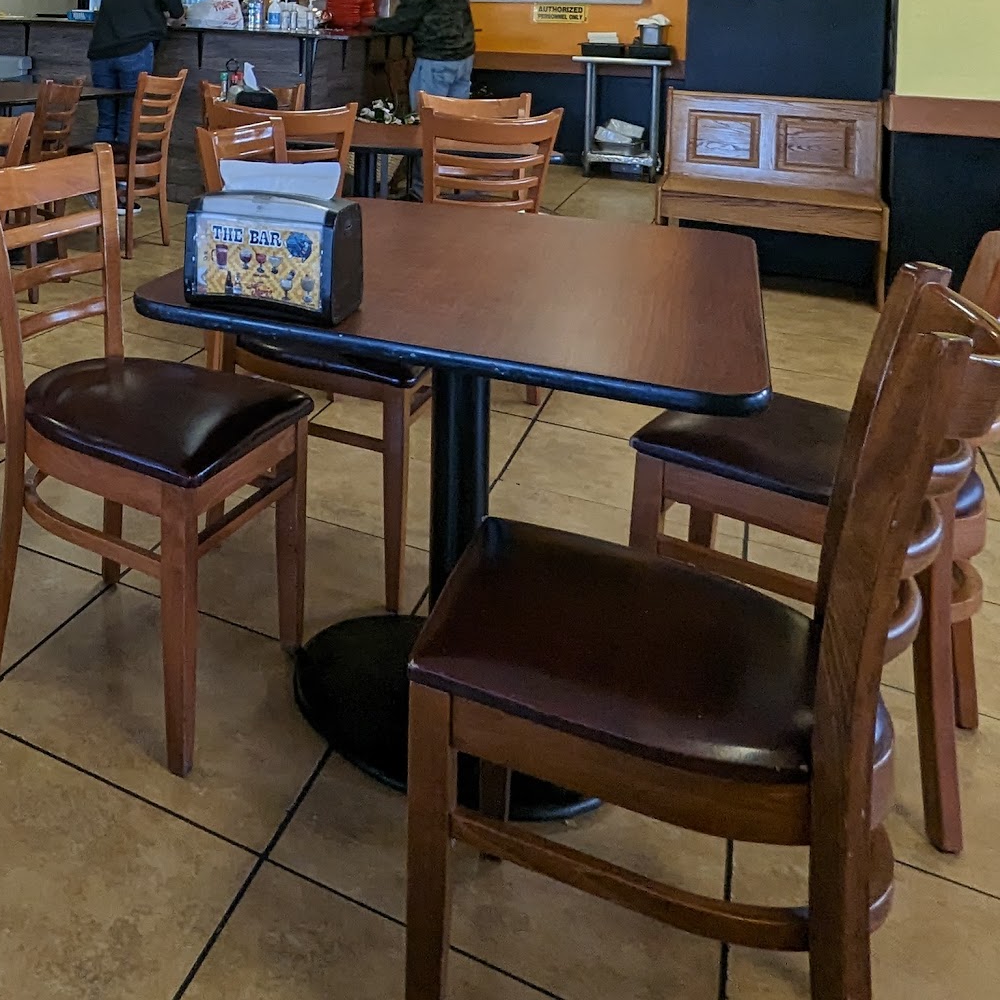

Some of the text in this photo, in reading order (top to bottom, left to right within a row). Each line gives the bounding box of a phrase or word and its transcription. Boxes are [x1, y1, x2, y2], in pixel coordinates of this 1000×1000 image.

[538, 5, 583, 13] AUTHORIZED
[212, 225, 282, 247] THE BAR
